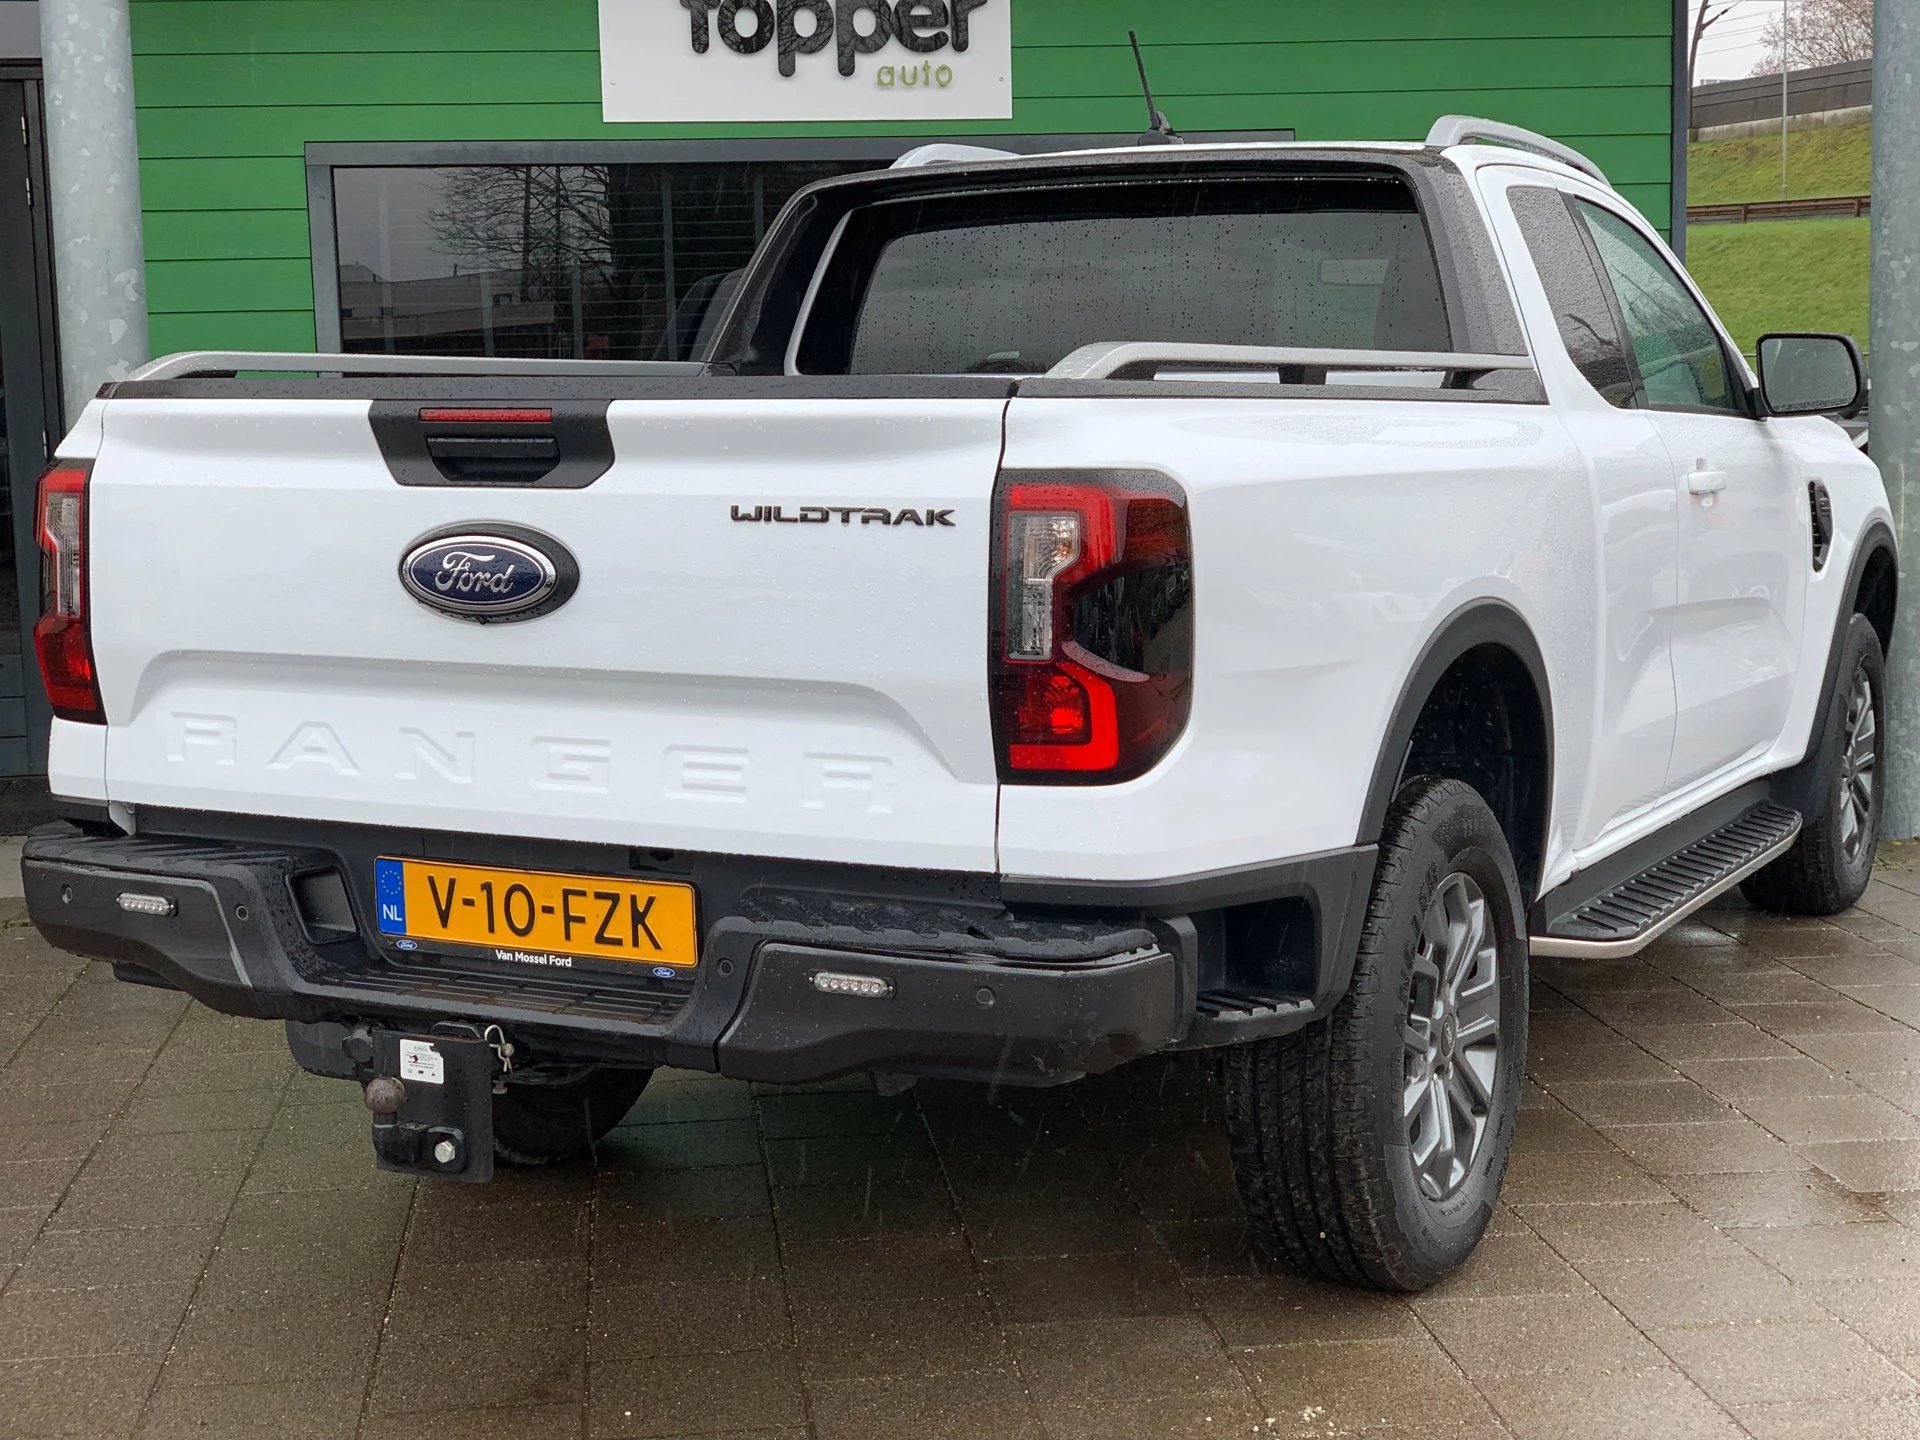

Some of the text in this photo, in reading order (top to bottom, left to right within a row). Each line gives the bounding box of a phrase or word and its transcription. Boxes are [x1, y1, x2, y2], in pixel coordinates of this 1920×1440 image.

[876, 60, 954, 88] auto
[730, 504, 957, 527] WILDTRAK
[434, 551, 516, 594] Ford
[166, 711, 895, 813] RANGER
[382, 903, 403, 922] NL
[426, 874, 664, 951] V-10-FZK
[495, 949, 572, 967] Van Mossel Ford
